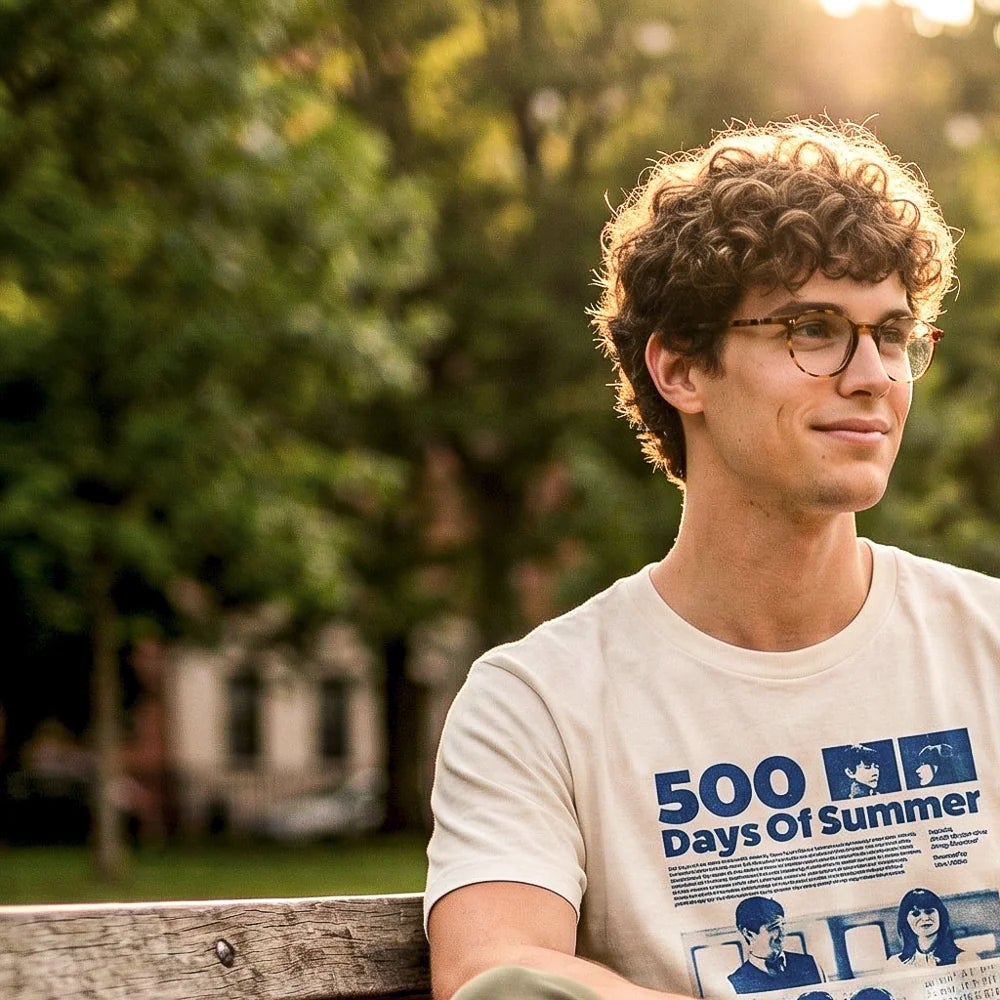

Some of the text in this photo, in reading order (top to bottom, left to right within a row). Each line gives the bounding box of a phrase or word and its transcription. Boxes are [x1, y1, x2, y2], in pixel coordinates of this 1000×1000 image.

[654, 755, 806, 825] 500
[661, 790, 981, 858] Days Of Summer
